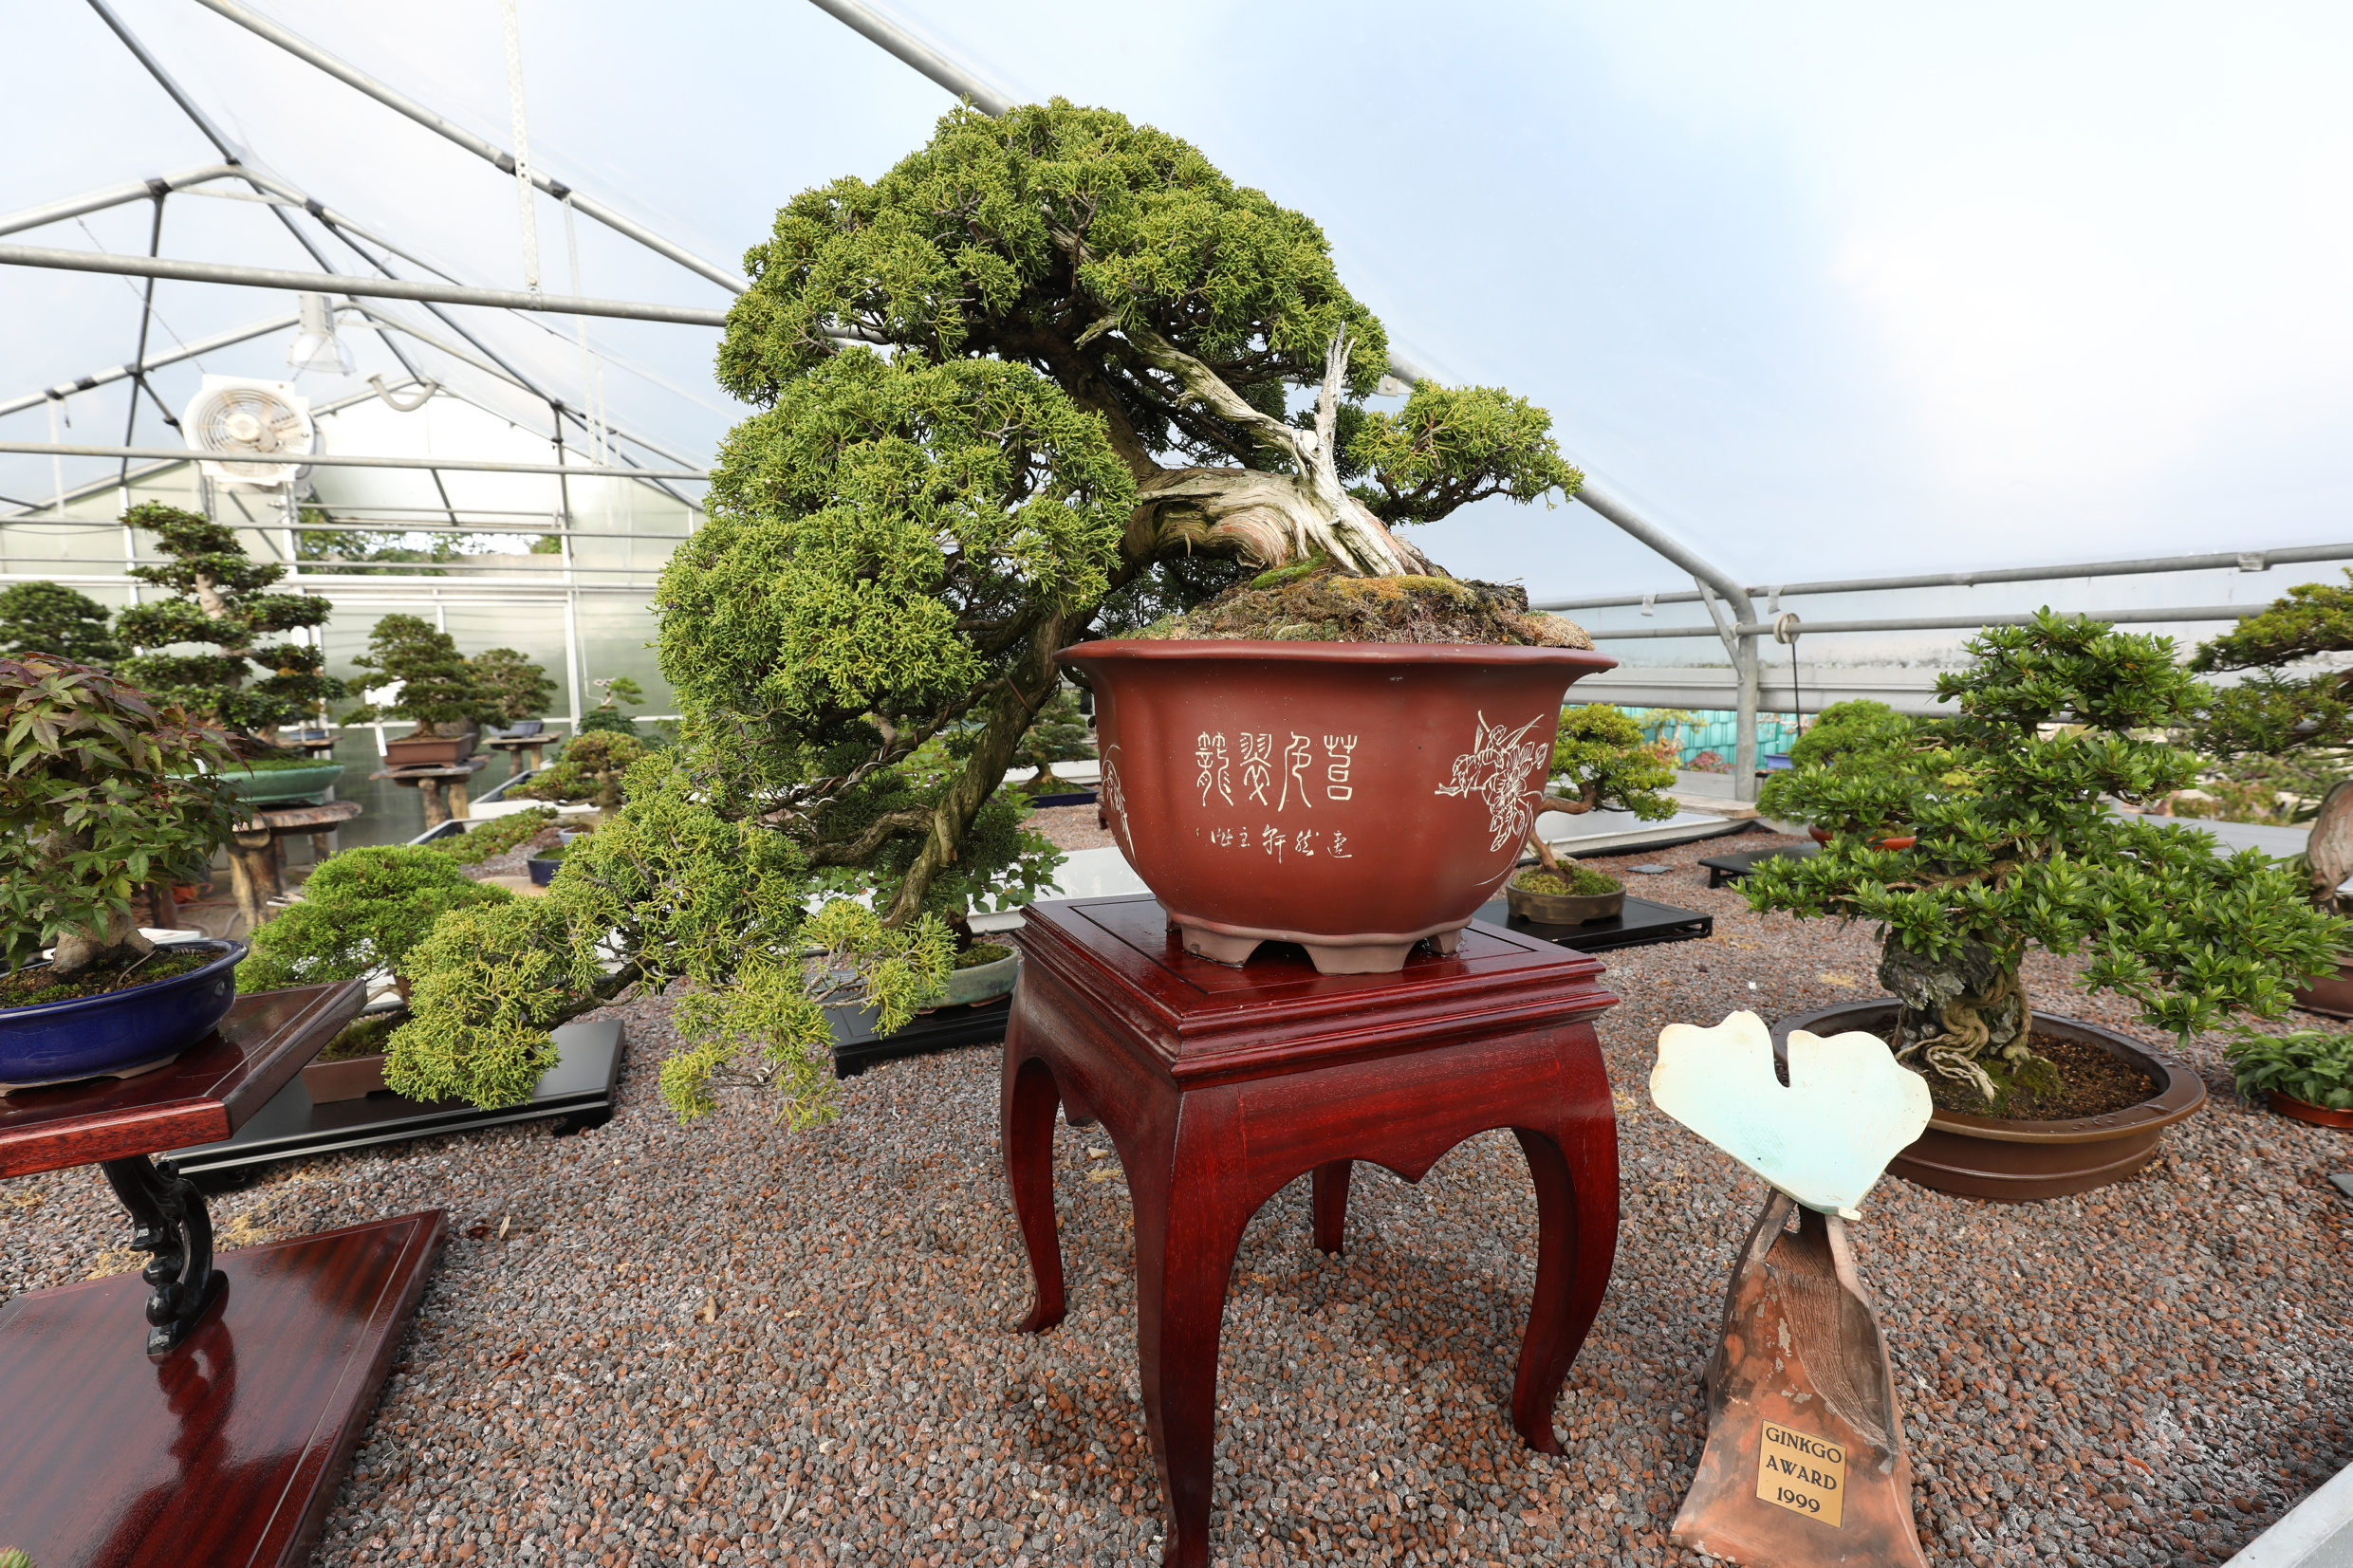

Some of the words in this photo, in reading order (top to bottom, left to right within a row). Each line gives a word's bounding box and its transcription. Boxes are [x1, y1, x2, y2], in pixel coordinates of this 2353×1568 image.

[1766, 1427, 1843, 1464] GINKGO
[1766, 1454, 1837, 1490] AWARD
[1776, 1486, 1821, 1513] 1999
